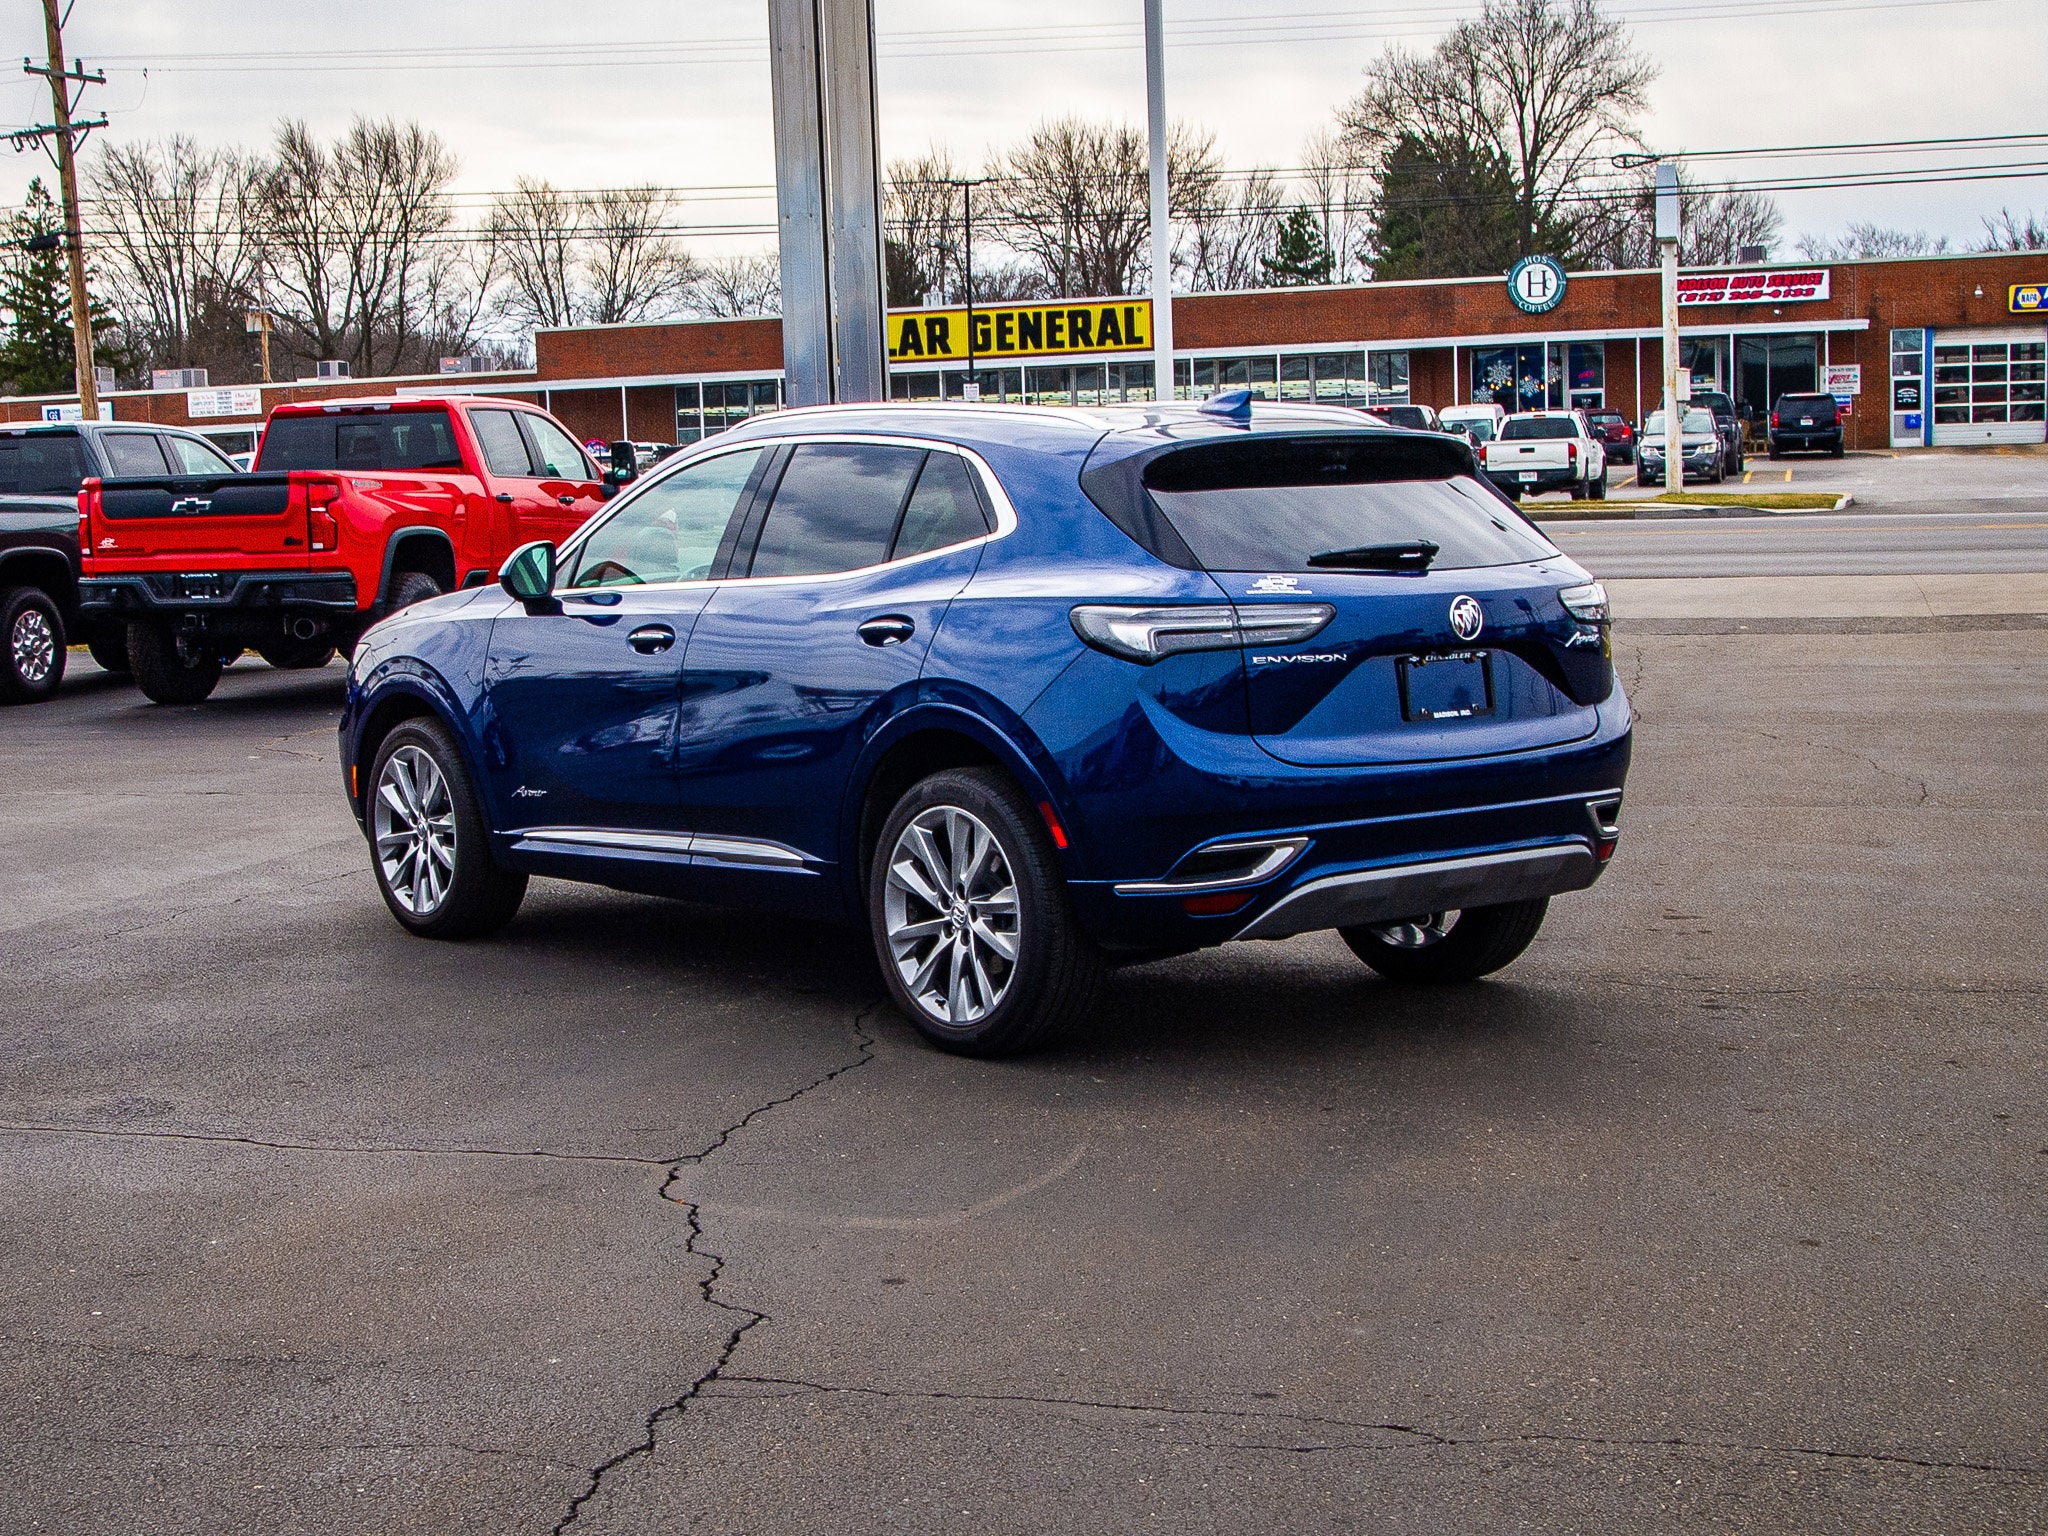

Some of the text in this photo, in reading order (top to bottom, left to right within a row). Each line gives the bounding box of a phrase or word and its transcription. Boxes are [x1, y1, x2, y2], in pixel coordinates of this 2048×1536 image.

[1730, 275, 1765, 289] AUTO
[1767, 272, 1824, 287] SERVICE
[2021, 292, 2038, 303] NAPA
[1518, 299, 1556, 313] COFFEE
[971, 306, 1144, 353] GENERAL
[1252, 653, 1348, 665] ENVISION
